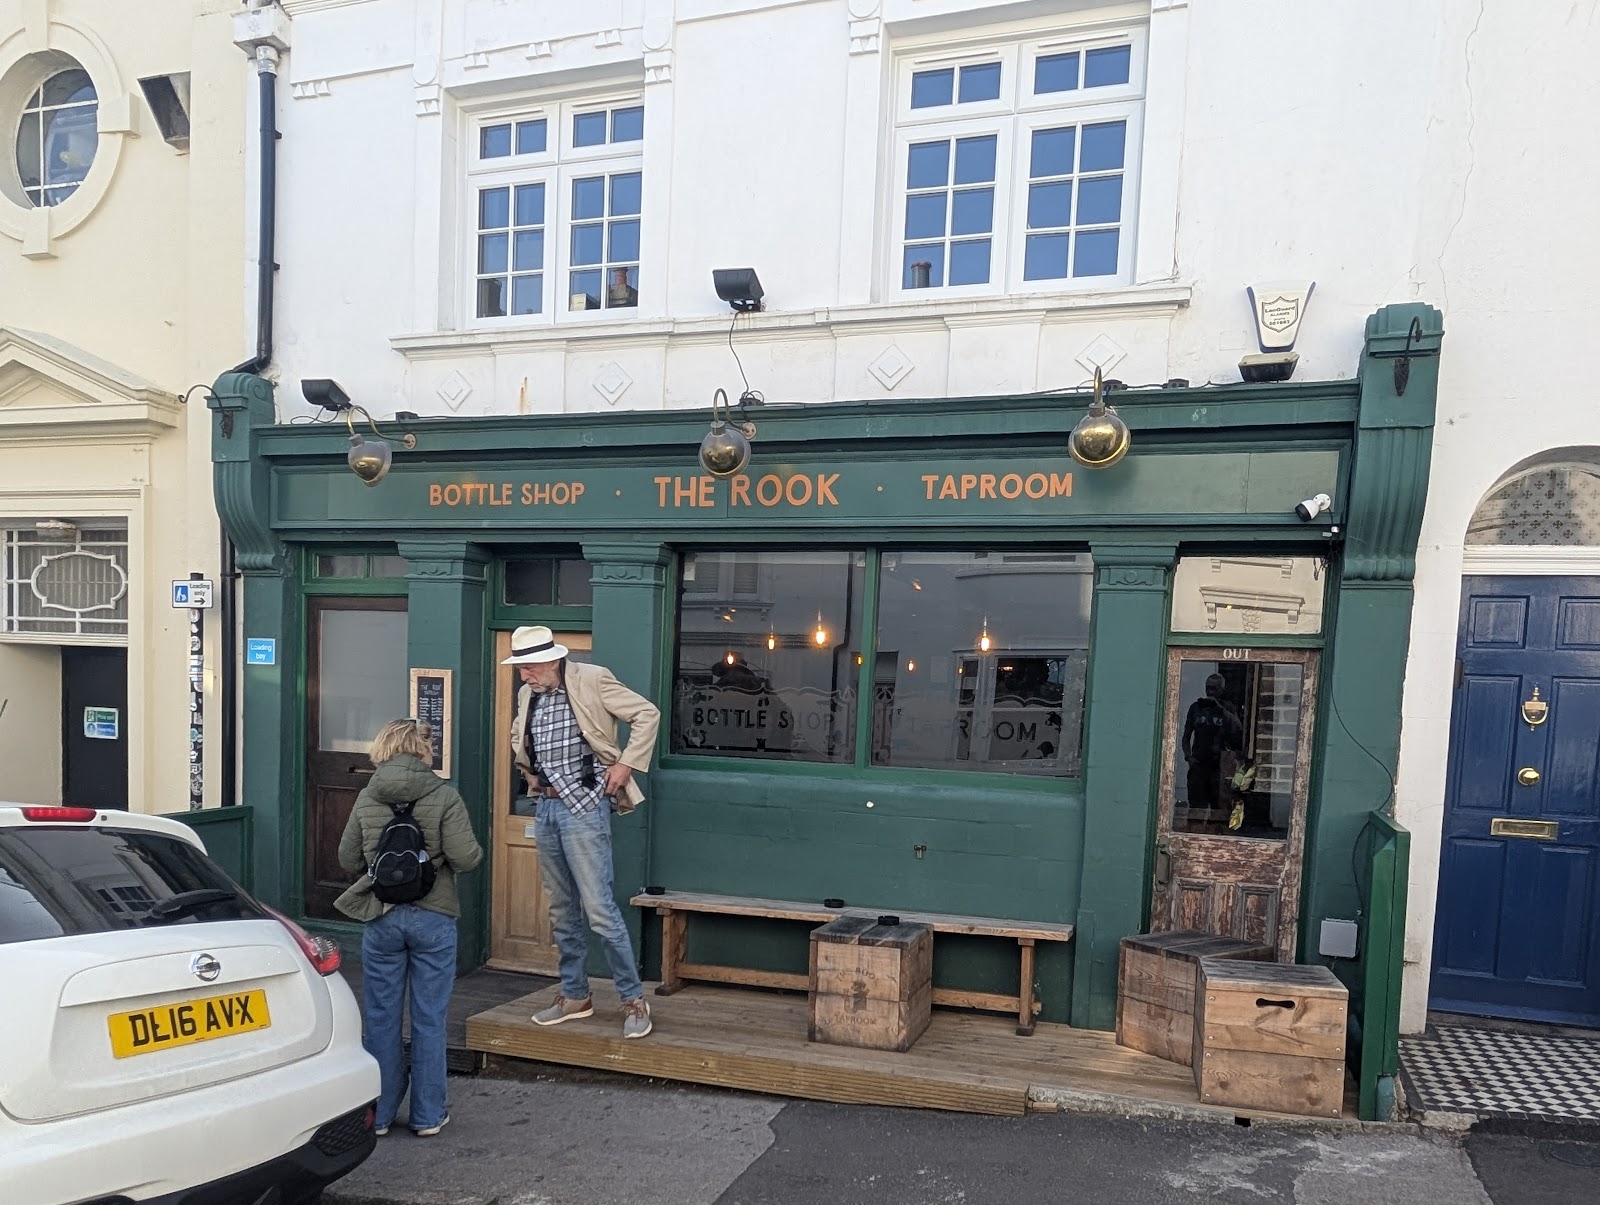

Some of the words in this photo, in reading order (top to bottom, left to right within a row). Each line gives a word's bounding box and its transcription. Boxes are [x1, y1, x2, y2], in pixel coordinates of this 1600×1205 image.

[429, 482, 513, 507] BOTTLE
[520, 481, 586, 506] SHOP
[654, 476, 716, 508] THE
[730, 473, 840, 507] ROOK
[921, 472, 1074, 500] TAPROOM
[250, 644, 272, 652] Loading
[255, 652, 267, 660] bay
[1222, 648, 1252, 660] OUT
[692, 708, 767, 729] BOTTLE
[128, 1005, 197, 1047] DL16
[206, 995, 254, 1032] AVX
